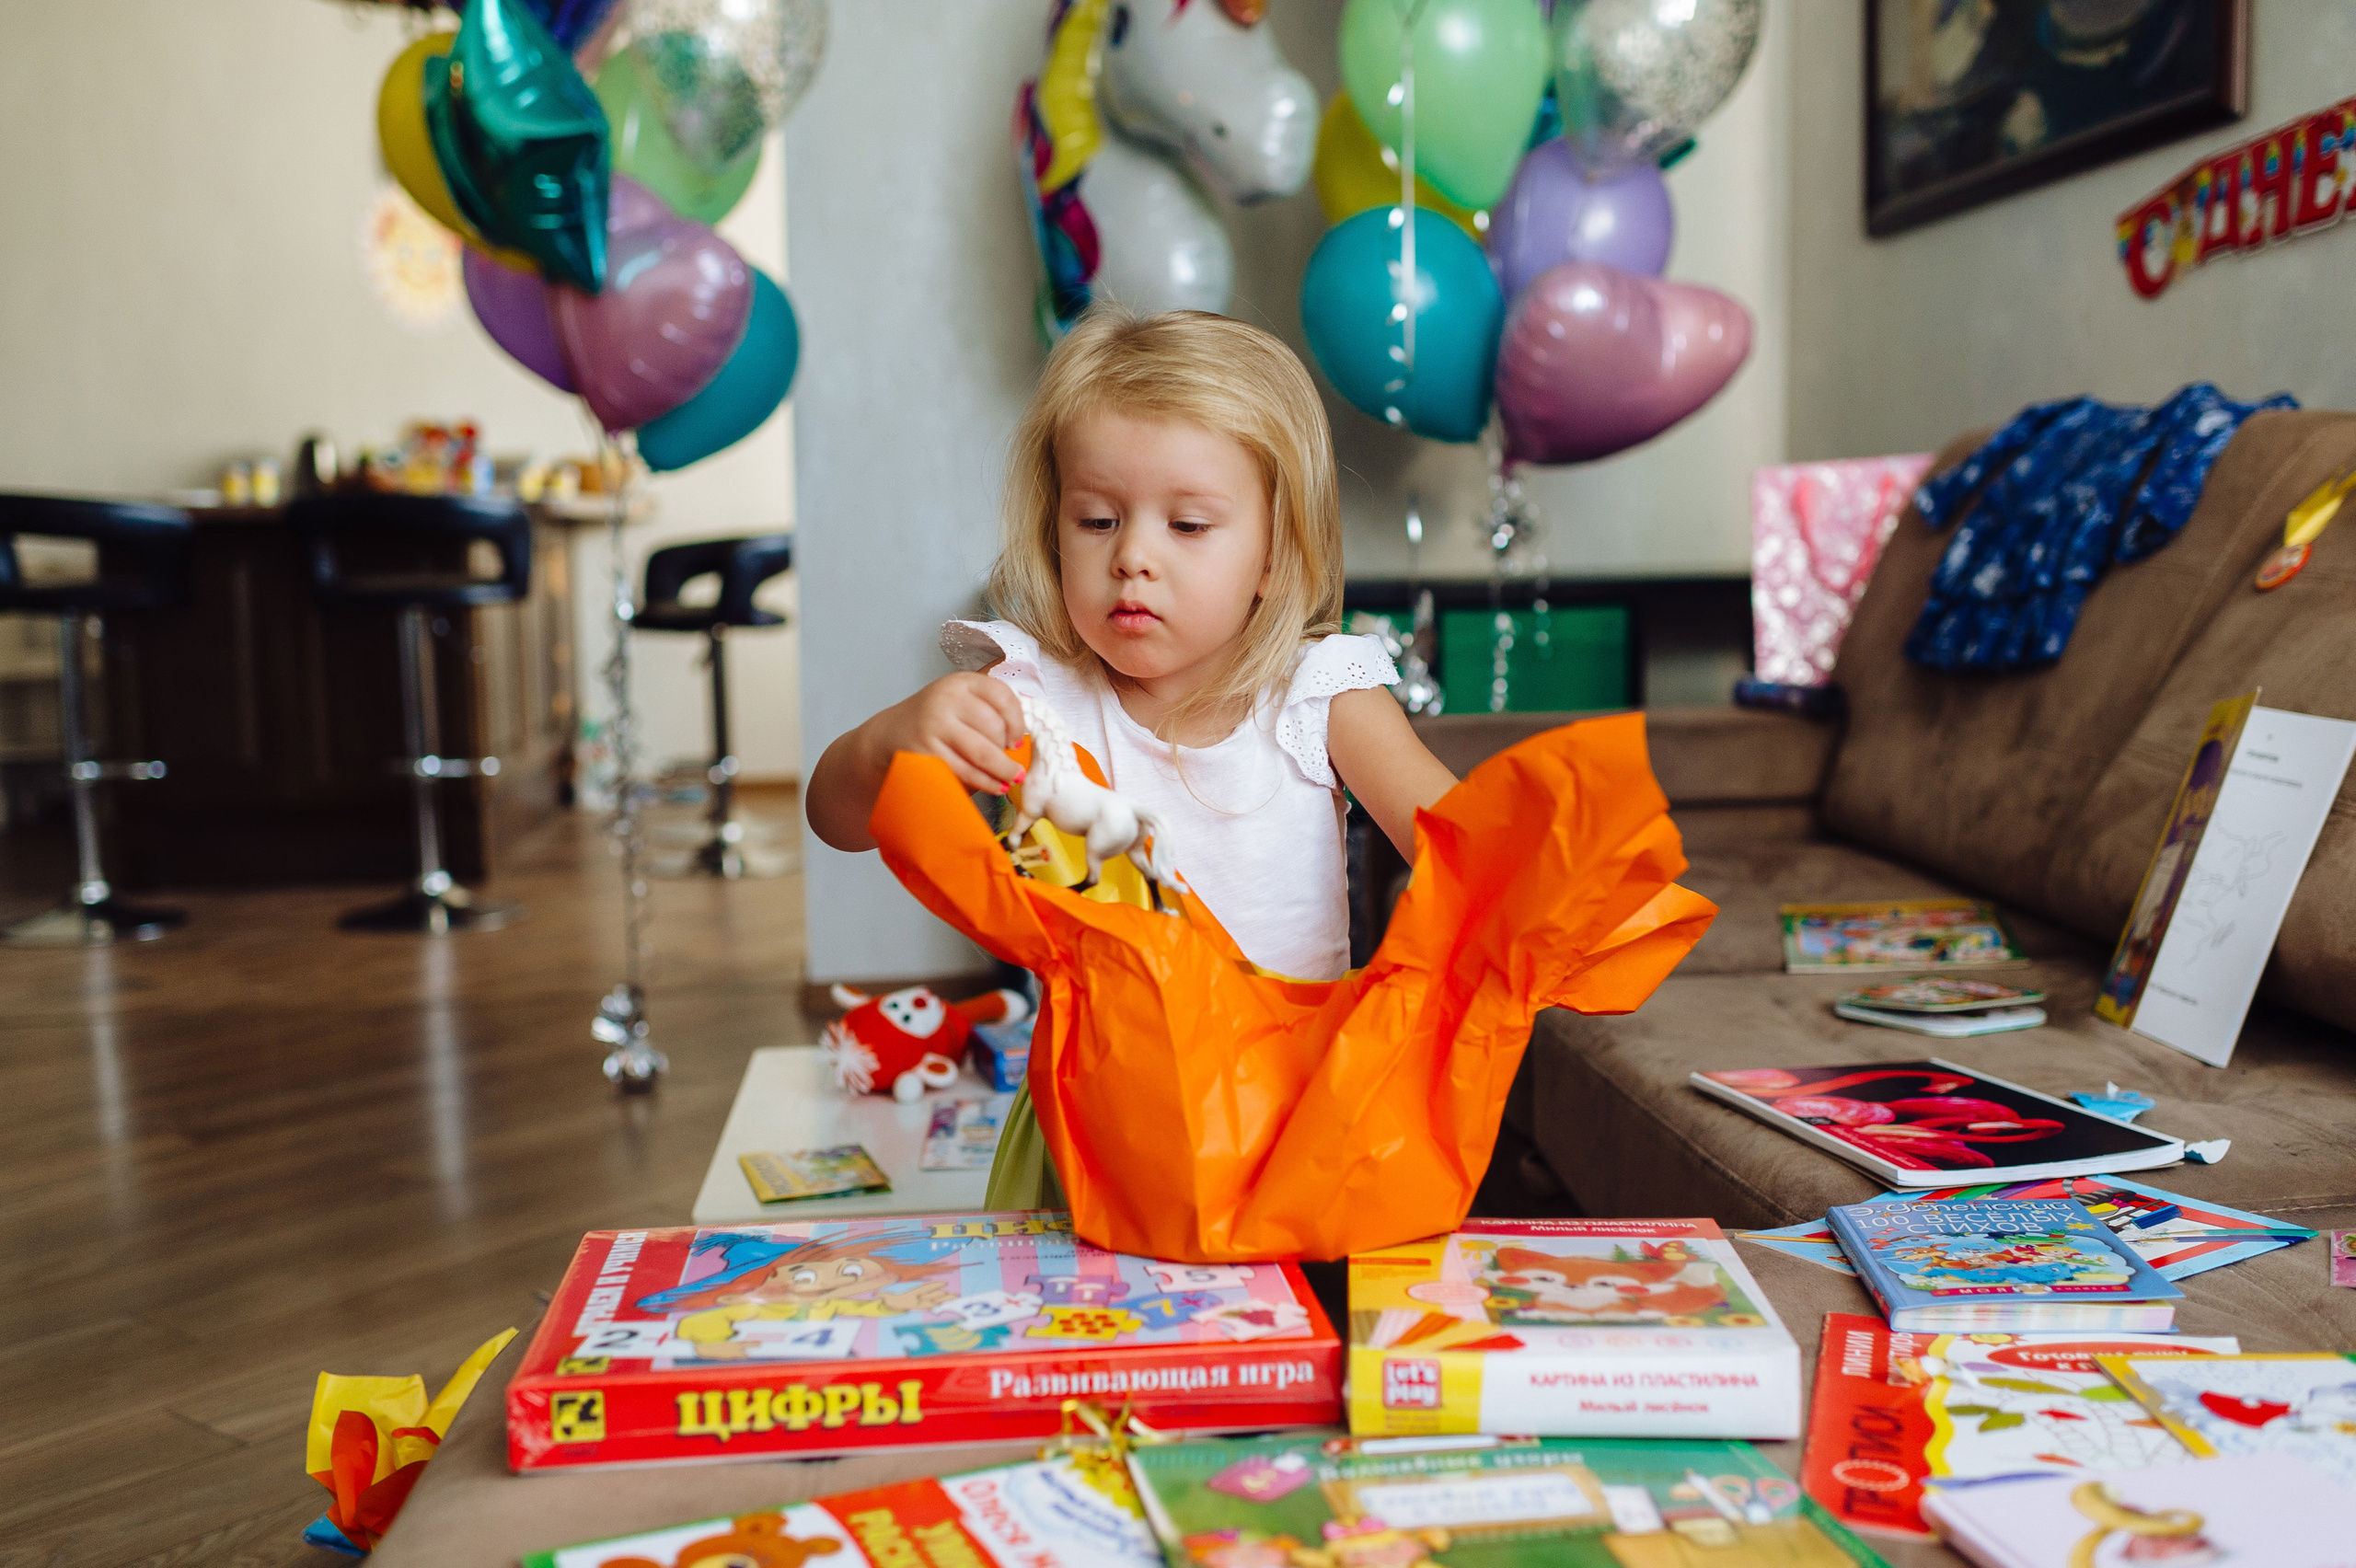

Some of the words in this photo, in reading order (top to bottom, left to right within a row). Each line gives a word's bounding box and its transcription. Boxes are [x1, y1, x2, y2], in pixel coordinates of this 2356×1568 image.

[1584, 1220, 1699, 1229] ПЛАСТИЛИНА
[1855, 1215, 1911, 1229] 100
[1922, 1210, 2084, 1225] ВЕСЁЛЫХ
[1907, 1223, 2046, 1234] СТИХОВ
[989, 1364, 1230, 1400] Развивающая
[1239, 1361, 1314, 1390] игра
[676, 1379, 924, 1443] ЦИФРЫ
